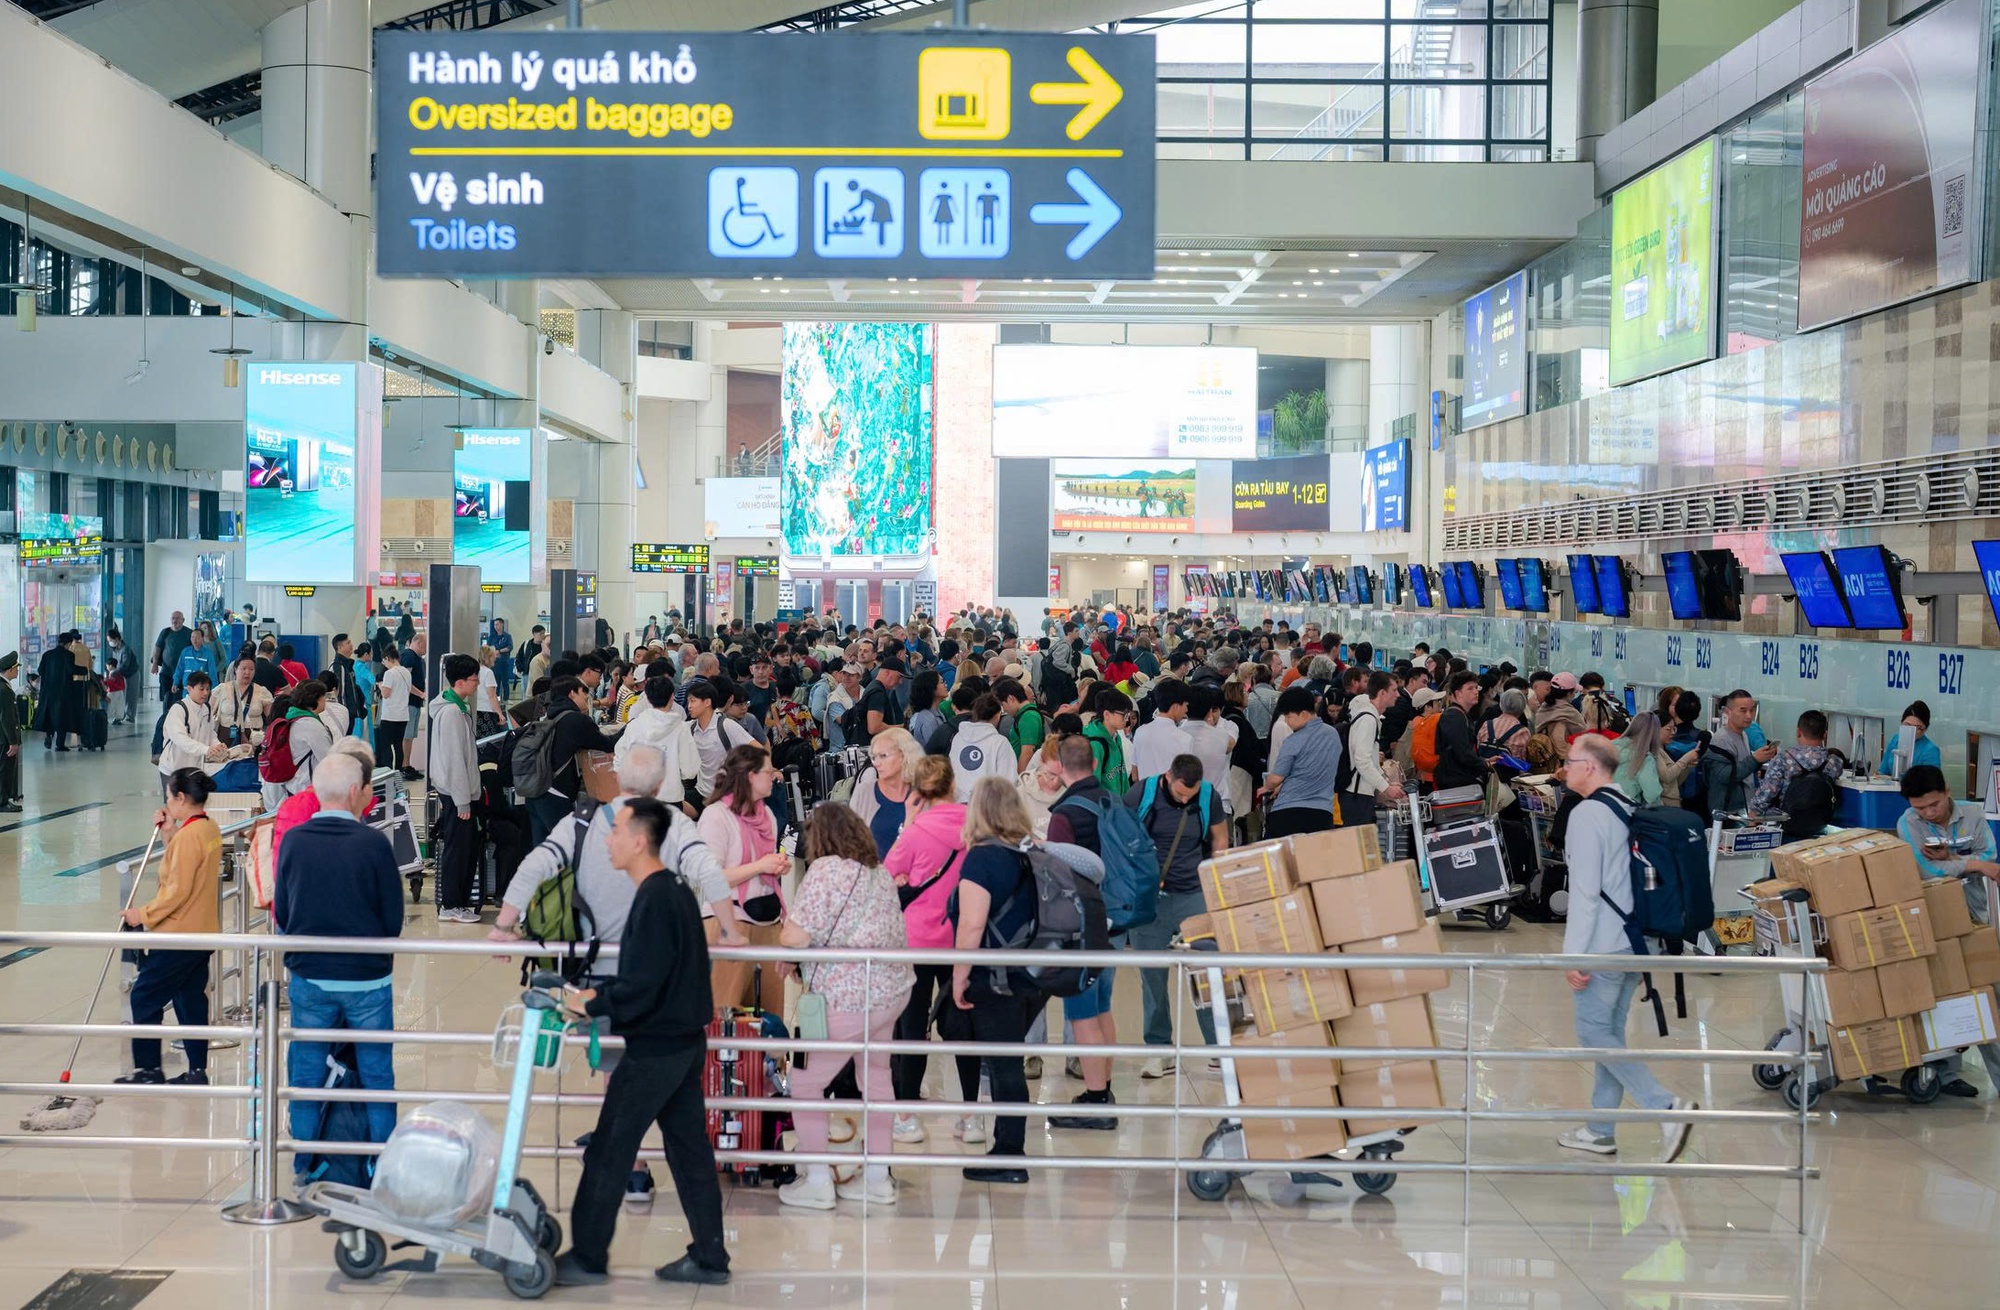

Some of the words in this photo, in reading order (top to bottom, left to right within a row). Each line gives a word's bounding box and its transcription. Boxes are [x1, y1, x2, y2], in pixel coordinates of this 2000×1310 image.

[409, 50, 502, 85] Hành
[512, 51, 545, 91] lý
[553, 48, 620, 91] quá
[630, 43, 697, 84] khổ
[409, 97, 577, 130] Oversized
[586, 97, 733, 138] baggage
[410, 173, 458, 211] Vệ
[465, 173, 544, 205] sinh
[1806, 188, 1824, 219] MỜI
[1826, 174, 1861, 213] QUẢNG
[1863, 161, 1886, 193] CÁO
[411, 218, 517, 250] Toilets
[260, 370, 341, 385] Hisense
[464, 434, 521, 446] Hisense
[1235, 481, 1249, 496] CỬA
[1250, 482, 1260, 496] RA
[1260, 479, 1274, 496] TÀU
[1275, 481, 1290, 495] BAY
[1292, 484, 1313, 504] 1-12
[1794, 576, 1814, 597] ACV
[1844, 574, 1866, 597] ACV
[1591, 630, 1603, 657] B20
[1615, 631, 1627, 660] B21
[1667, 635, 1681, 666] B22
[1696, 638, 1711, 669] B23
[1762, 641, 1780, 676] B24
[1800, 643, 1819, 680] B25
[1887, 650, 1910, 689] B26
[1938, 653, 1964, 695] B27
[972, 751, 979, 759] 3
